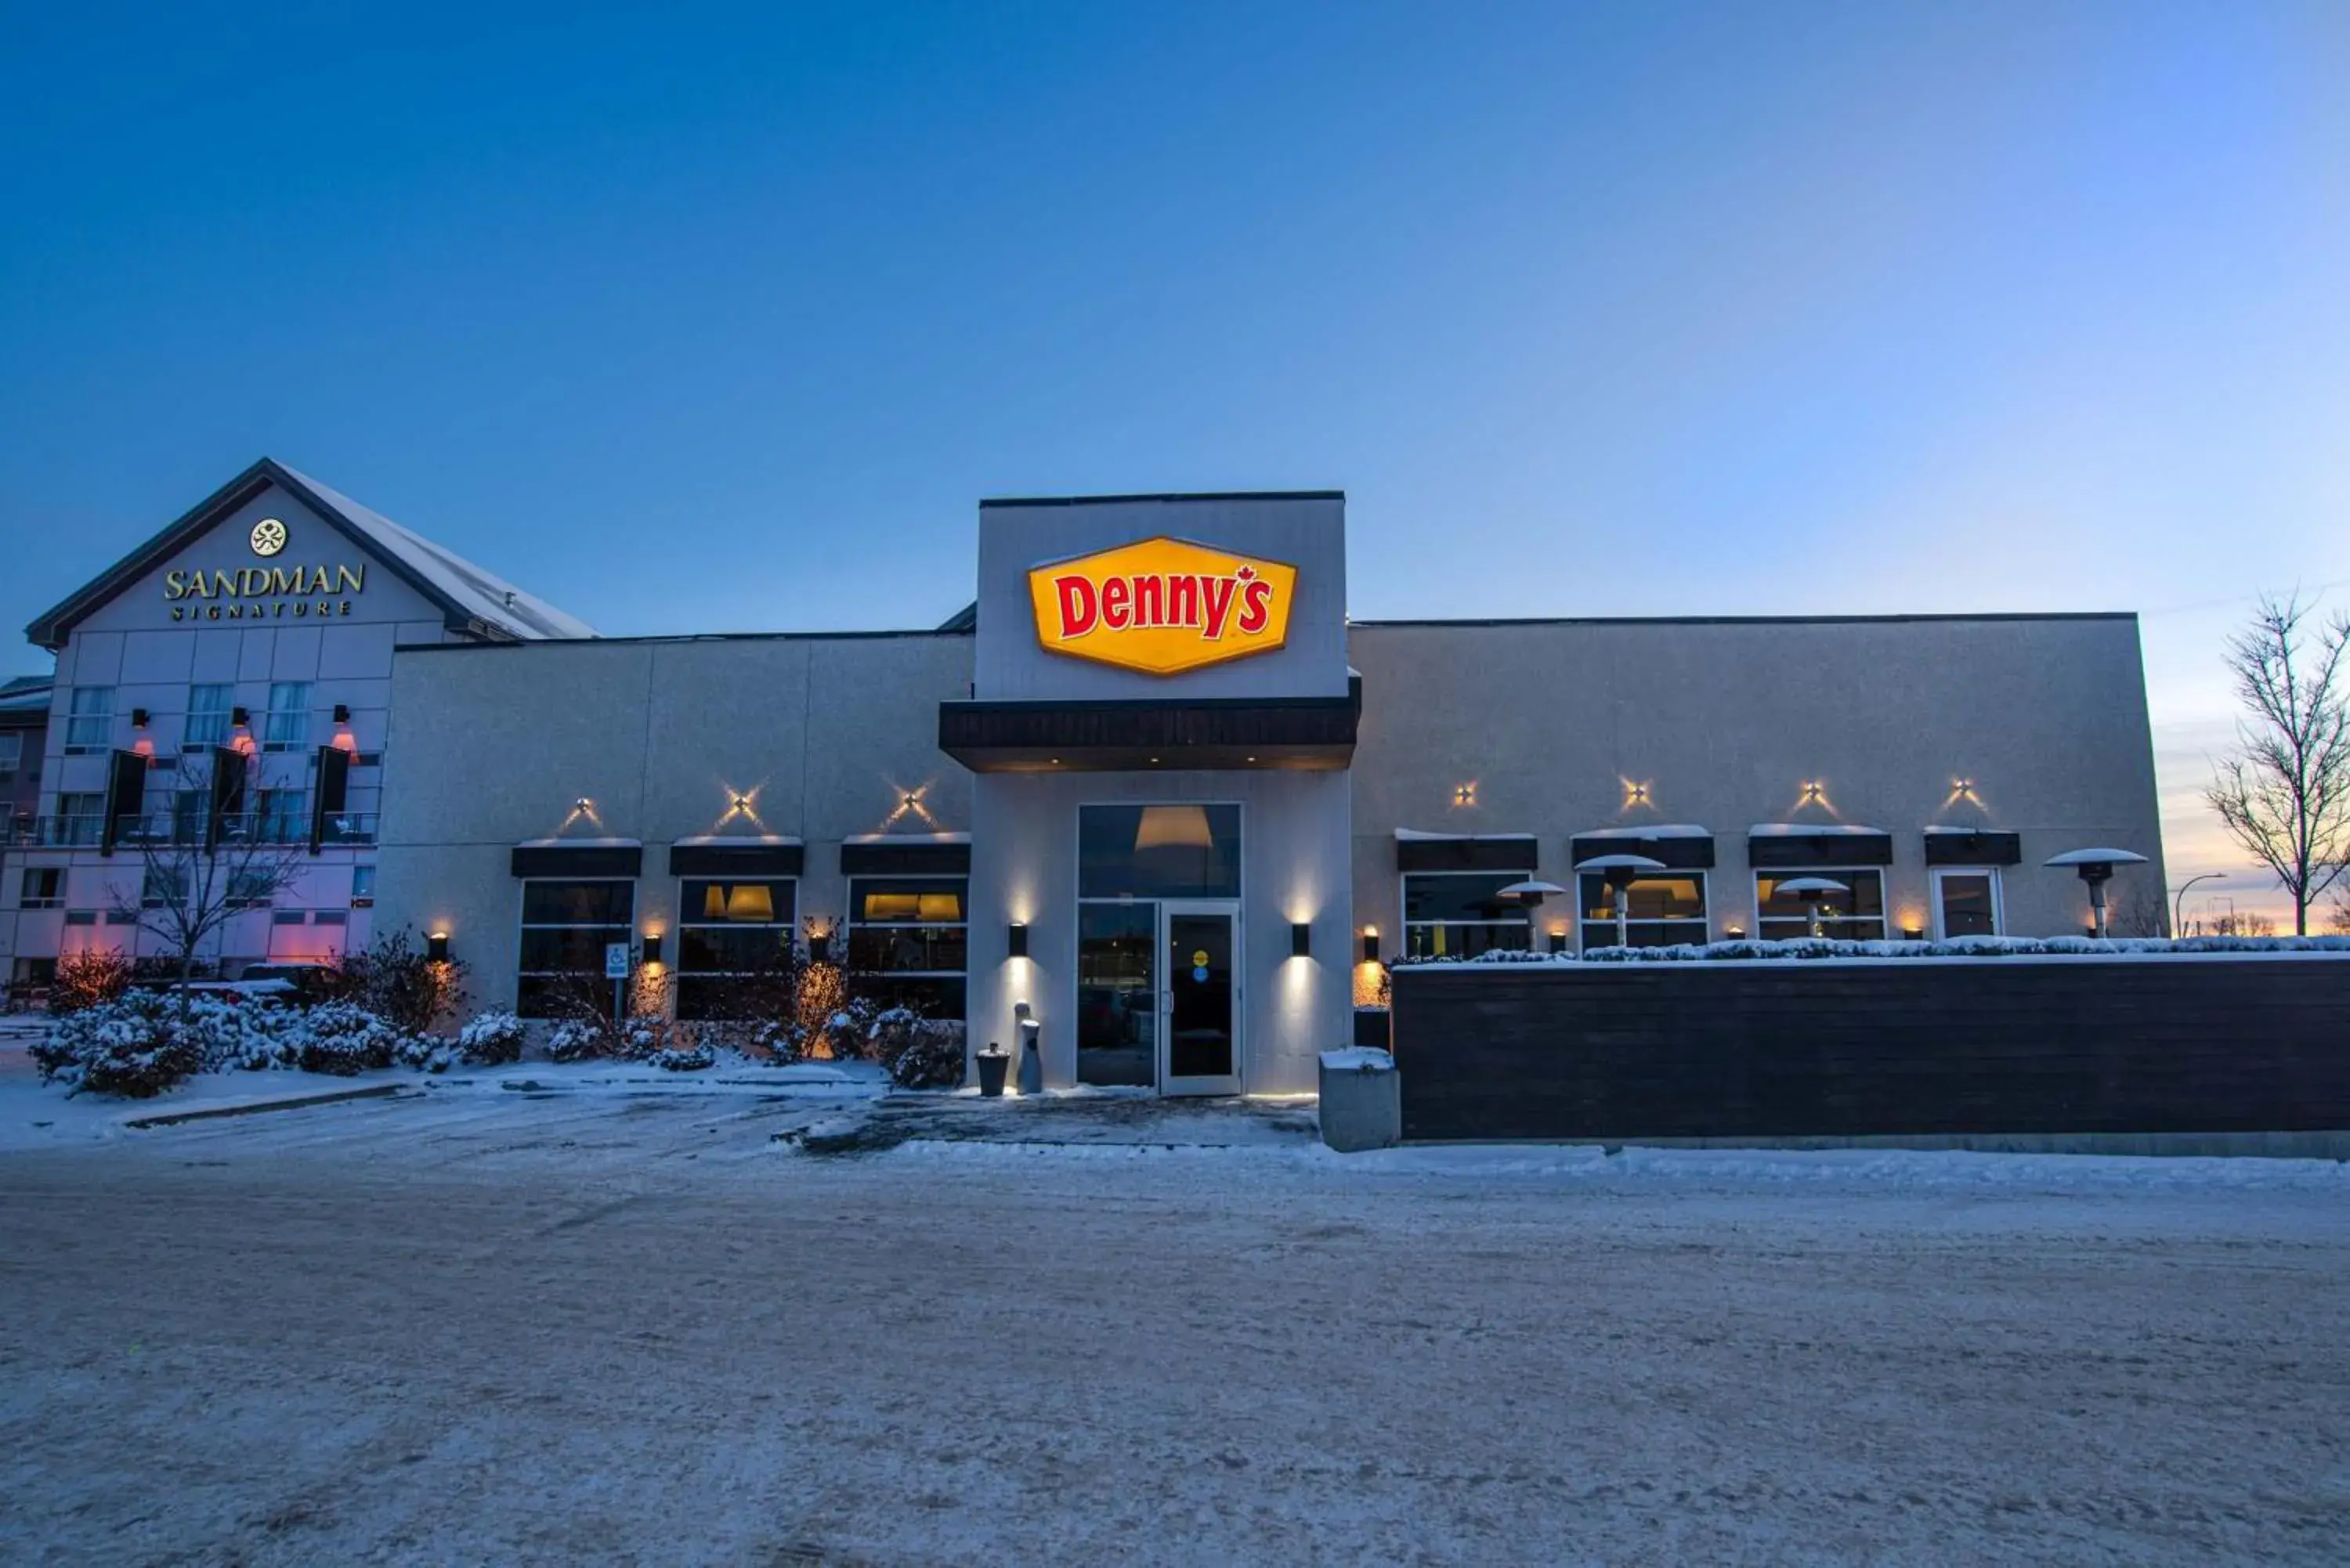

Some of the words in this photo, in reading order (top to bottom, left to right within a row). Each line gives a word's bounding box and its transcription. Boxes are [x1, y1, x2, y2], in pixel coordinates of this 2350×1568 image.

[164, 563, 364, 600] SANDMAN
[172, 601, 352, 621] SIGNATURE
[1054, 564, 1274, 641] Denny's
